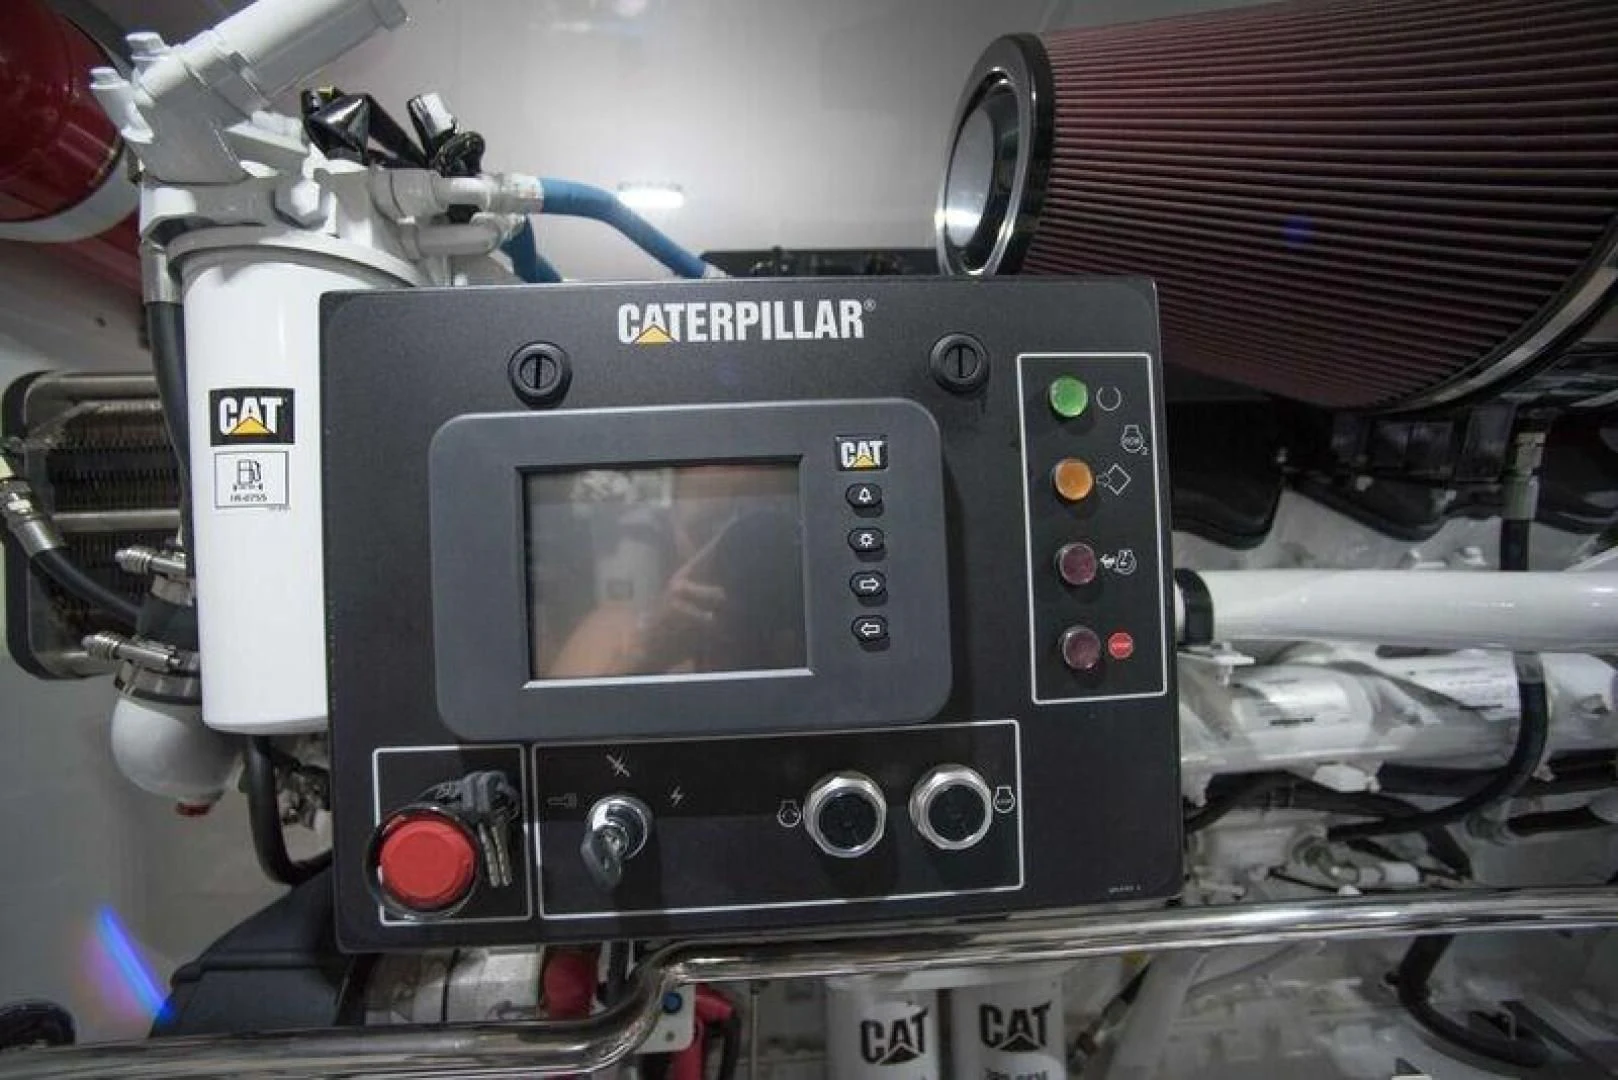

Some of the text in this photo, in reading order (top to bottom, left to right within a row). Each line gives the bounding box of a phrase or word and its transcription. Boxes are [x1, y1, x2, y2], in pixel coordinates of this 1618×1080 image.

[219, 396, 283, 435] CAT
[840, 440, 883, 468] CAT
[860, 1006, 930, 1066] CAT
[979, 999, 1053, 1052] CAT
